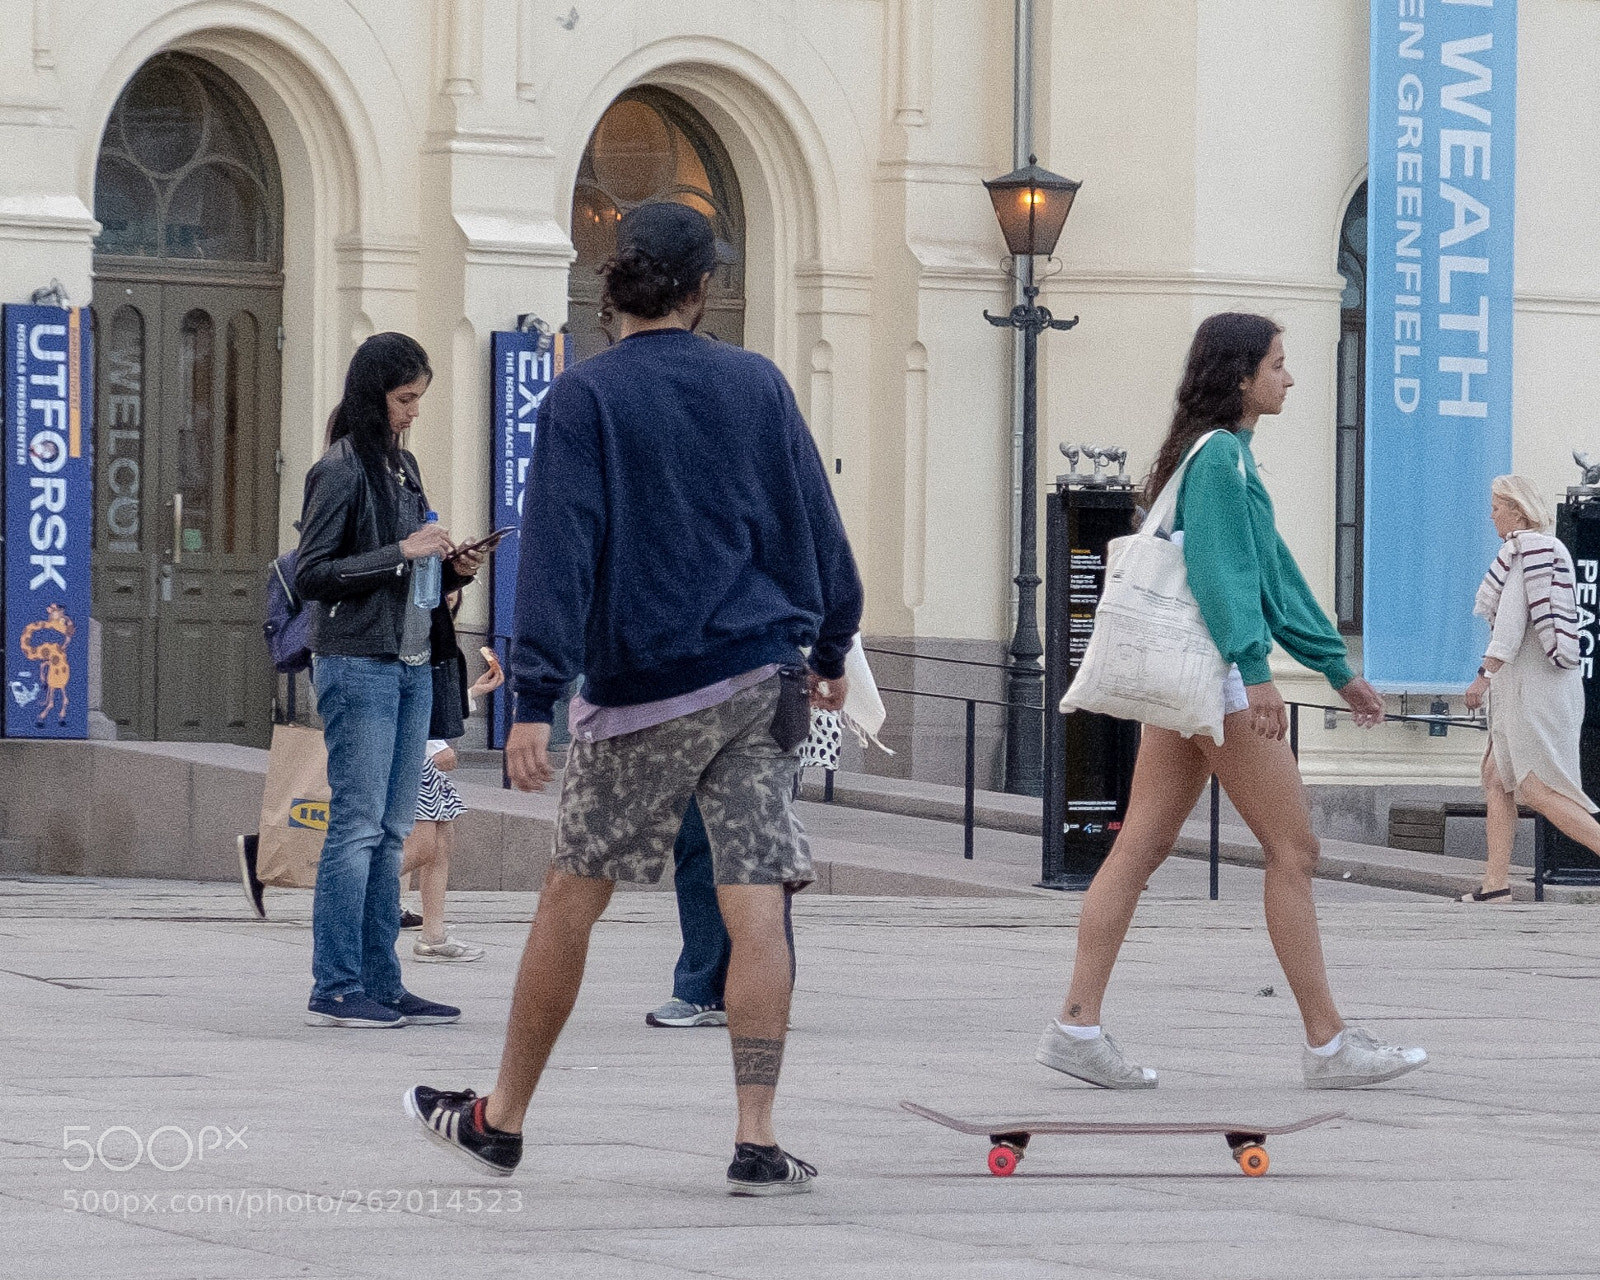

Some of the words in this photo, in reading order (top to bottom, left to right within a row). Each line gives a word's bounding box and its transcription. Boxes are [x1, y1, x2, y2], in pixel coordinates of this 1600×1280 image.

[1393, 73, 1424, 413] GREENFIELD
[1438, 32, 1494, 418] WEALTH
[17, 323, 26, 374] NOBELS
[505, 351, 514, 374] THE
[16, 375, 26, 466] FREDSSENTER
[505, 376, 514, 416] NOBEL
[505, 418, 514, 457] PEACE
[29, 323, 67, 593] UTFORSK
[107, 350, 141, 554] WELCO
[504, 459, 513, 507] CENTER
[1576, 558, 1599, 680] PEACE
